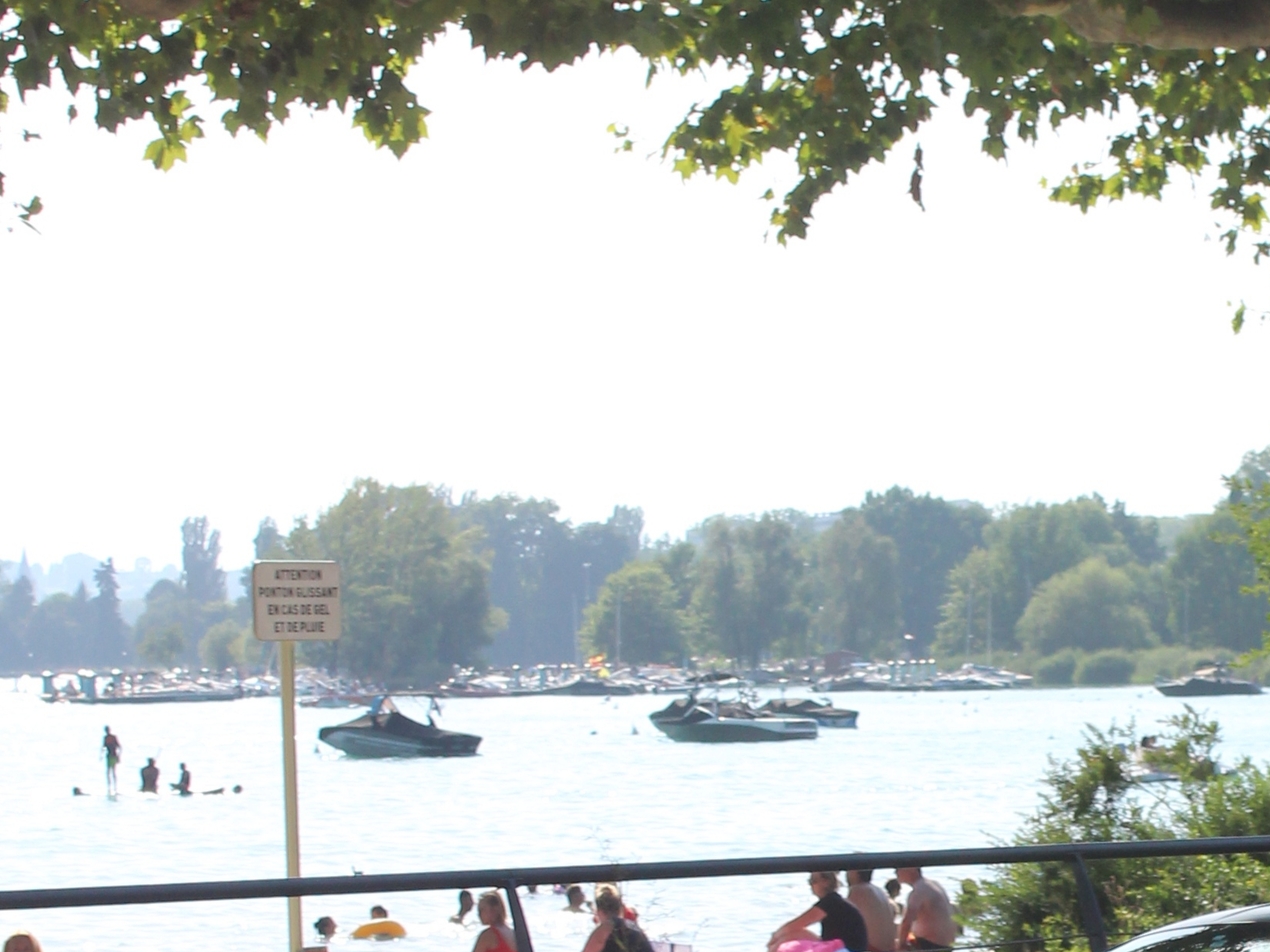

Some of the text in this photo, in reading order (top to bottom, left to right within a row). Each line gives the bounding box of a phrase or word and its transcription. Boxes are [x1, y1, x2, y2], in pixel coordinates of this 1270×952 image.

[275, 570, 323, 580] ATTENTION
[259, 587, 338, 598] PONTON GLISSANT
[268, 604, 330, 615] EN CAS DE GEL
[275, 621, 325, 633] ET DE PLUIE
